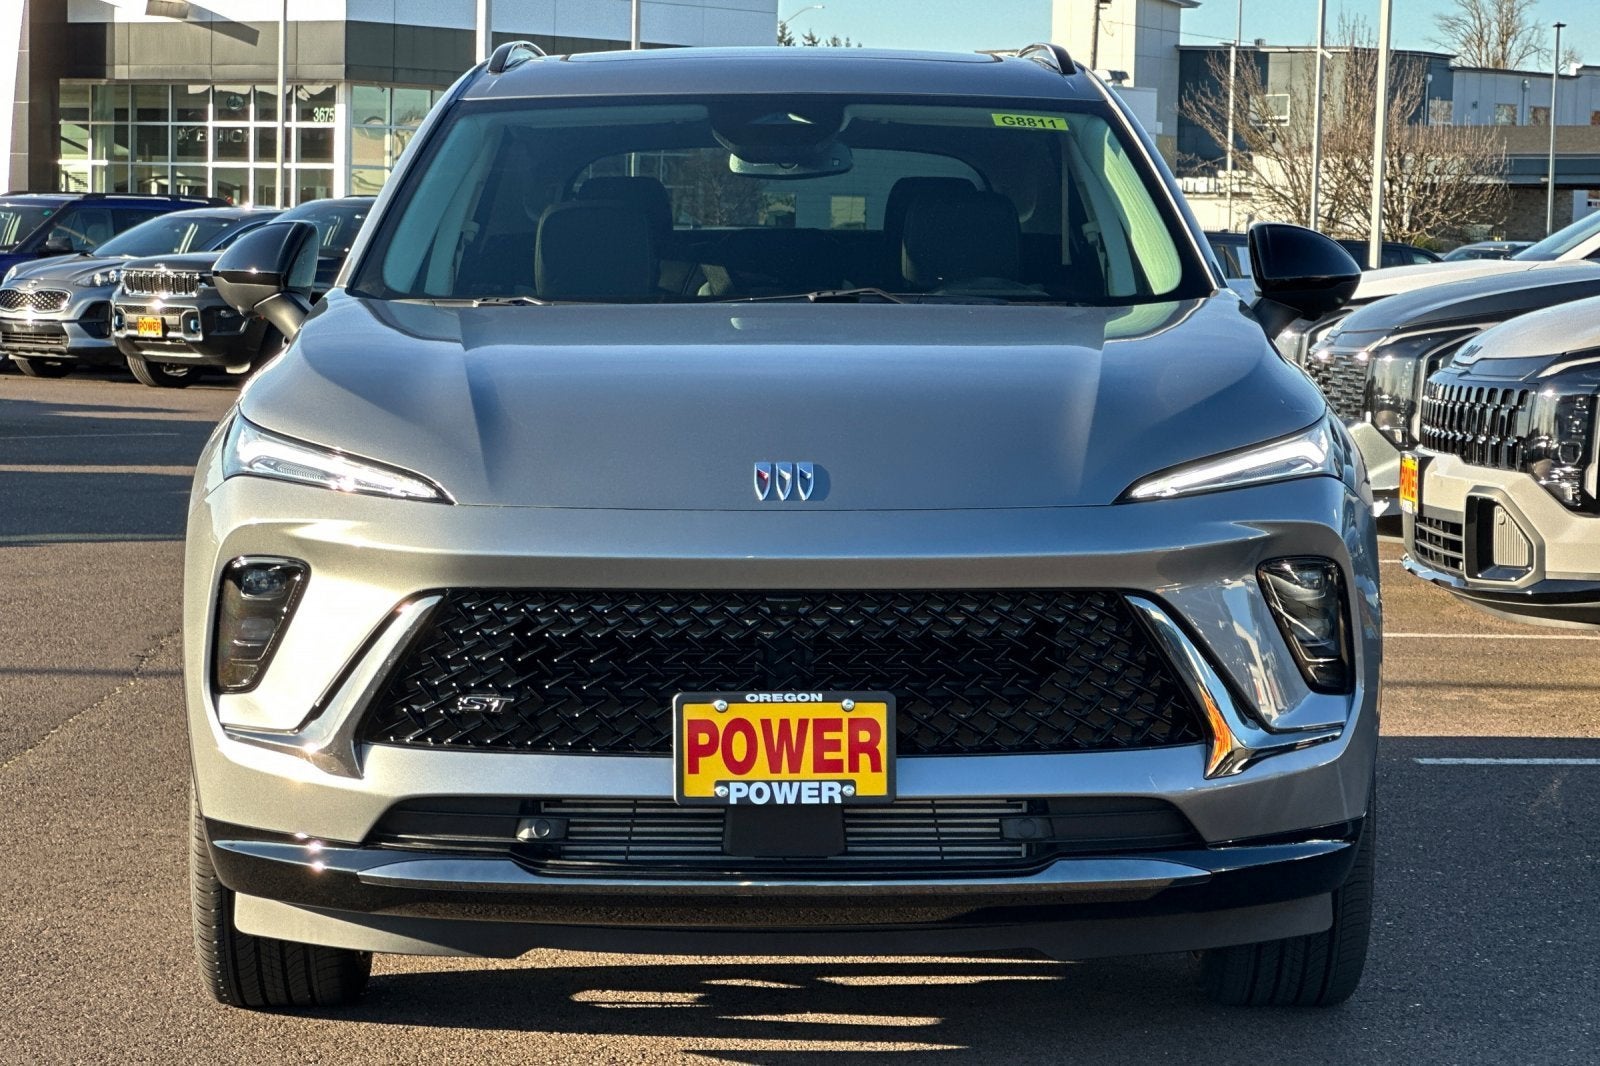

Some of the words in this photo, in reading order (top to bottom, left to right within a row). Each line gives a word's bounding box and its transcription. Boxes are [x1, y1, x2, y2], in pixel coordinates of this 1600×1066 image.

[313, 107, 335, 122] 3675
[1001, 115, 1057, 129] G8811
[138, 321, 161, 332] POWER
[745, 693, 823, 702] OREGON
[687, 717, 882, 776] POWER
[729, 782, 842, 805] POWER
